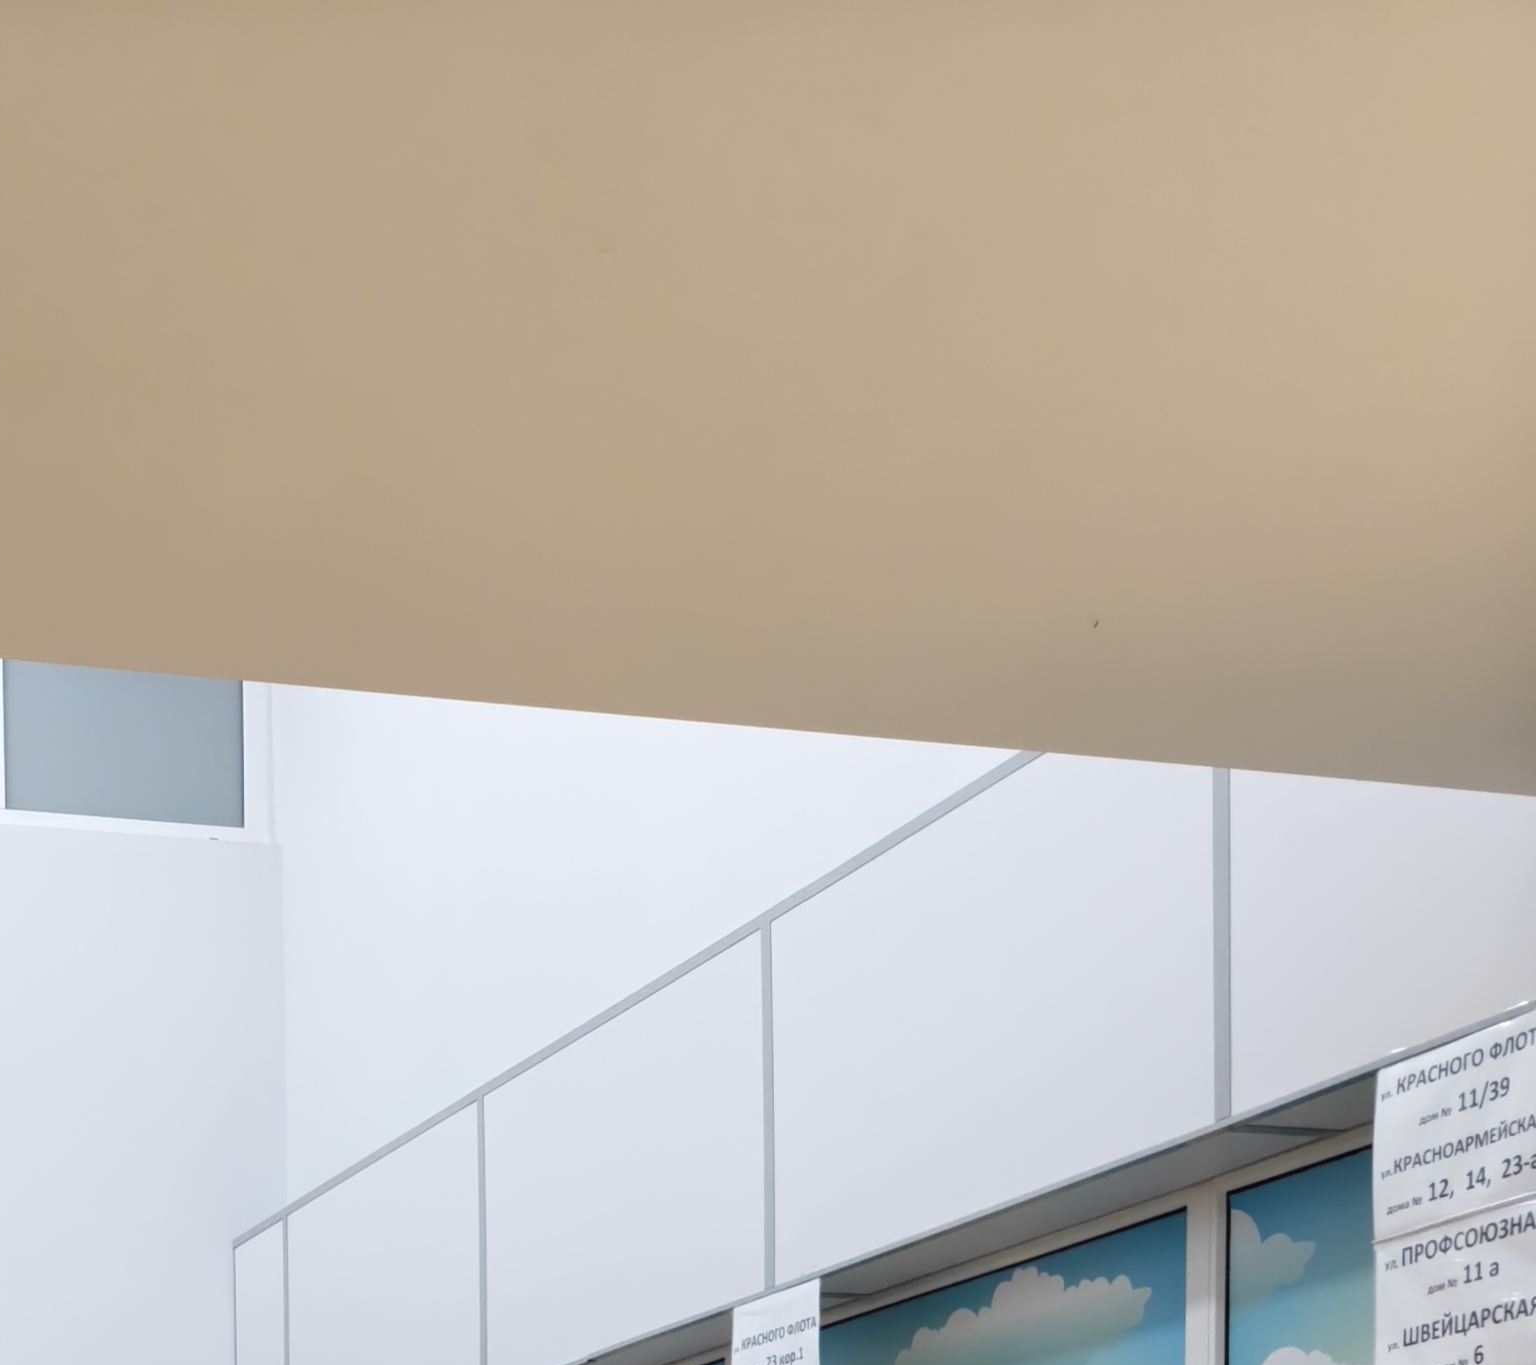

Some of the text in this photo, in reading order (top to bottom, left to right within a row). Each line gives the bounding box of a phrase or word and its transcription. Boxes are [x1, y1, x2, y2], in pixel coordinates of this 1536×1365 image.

[1396, 1048, 1484, 1095] КРАСНОГО
[1419, 1077, 1510, 1127] дом № 11/39
[1386, 1200, 1409, 1216] дома
[1428, 1178, 1454, 1202] 12,
[1465, 1166, 1492, 1190] 14,
[1401, 1211, 1536, 1267] ПРОФСОЮЗНА
[1427, 1261, 1500, 1296] дом № 11 а
[741, 1316, 817, 1351] КРАСНОГО ФЛОТА
[779, 1346, 804, 1365] кор.1
[1474, 1345, 1485, 1365] 6
